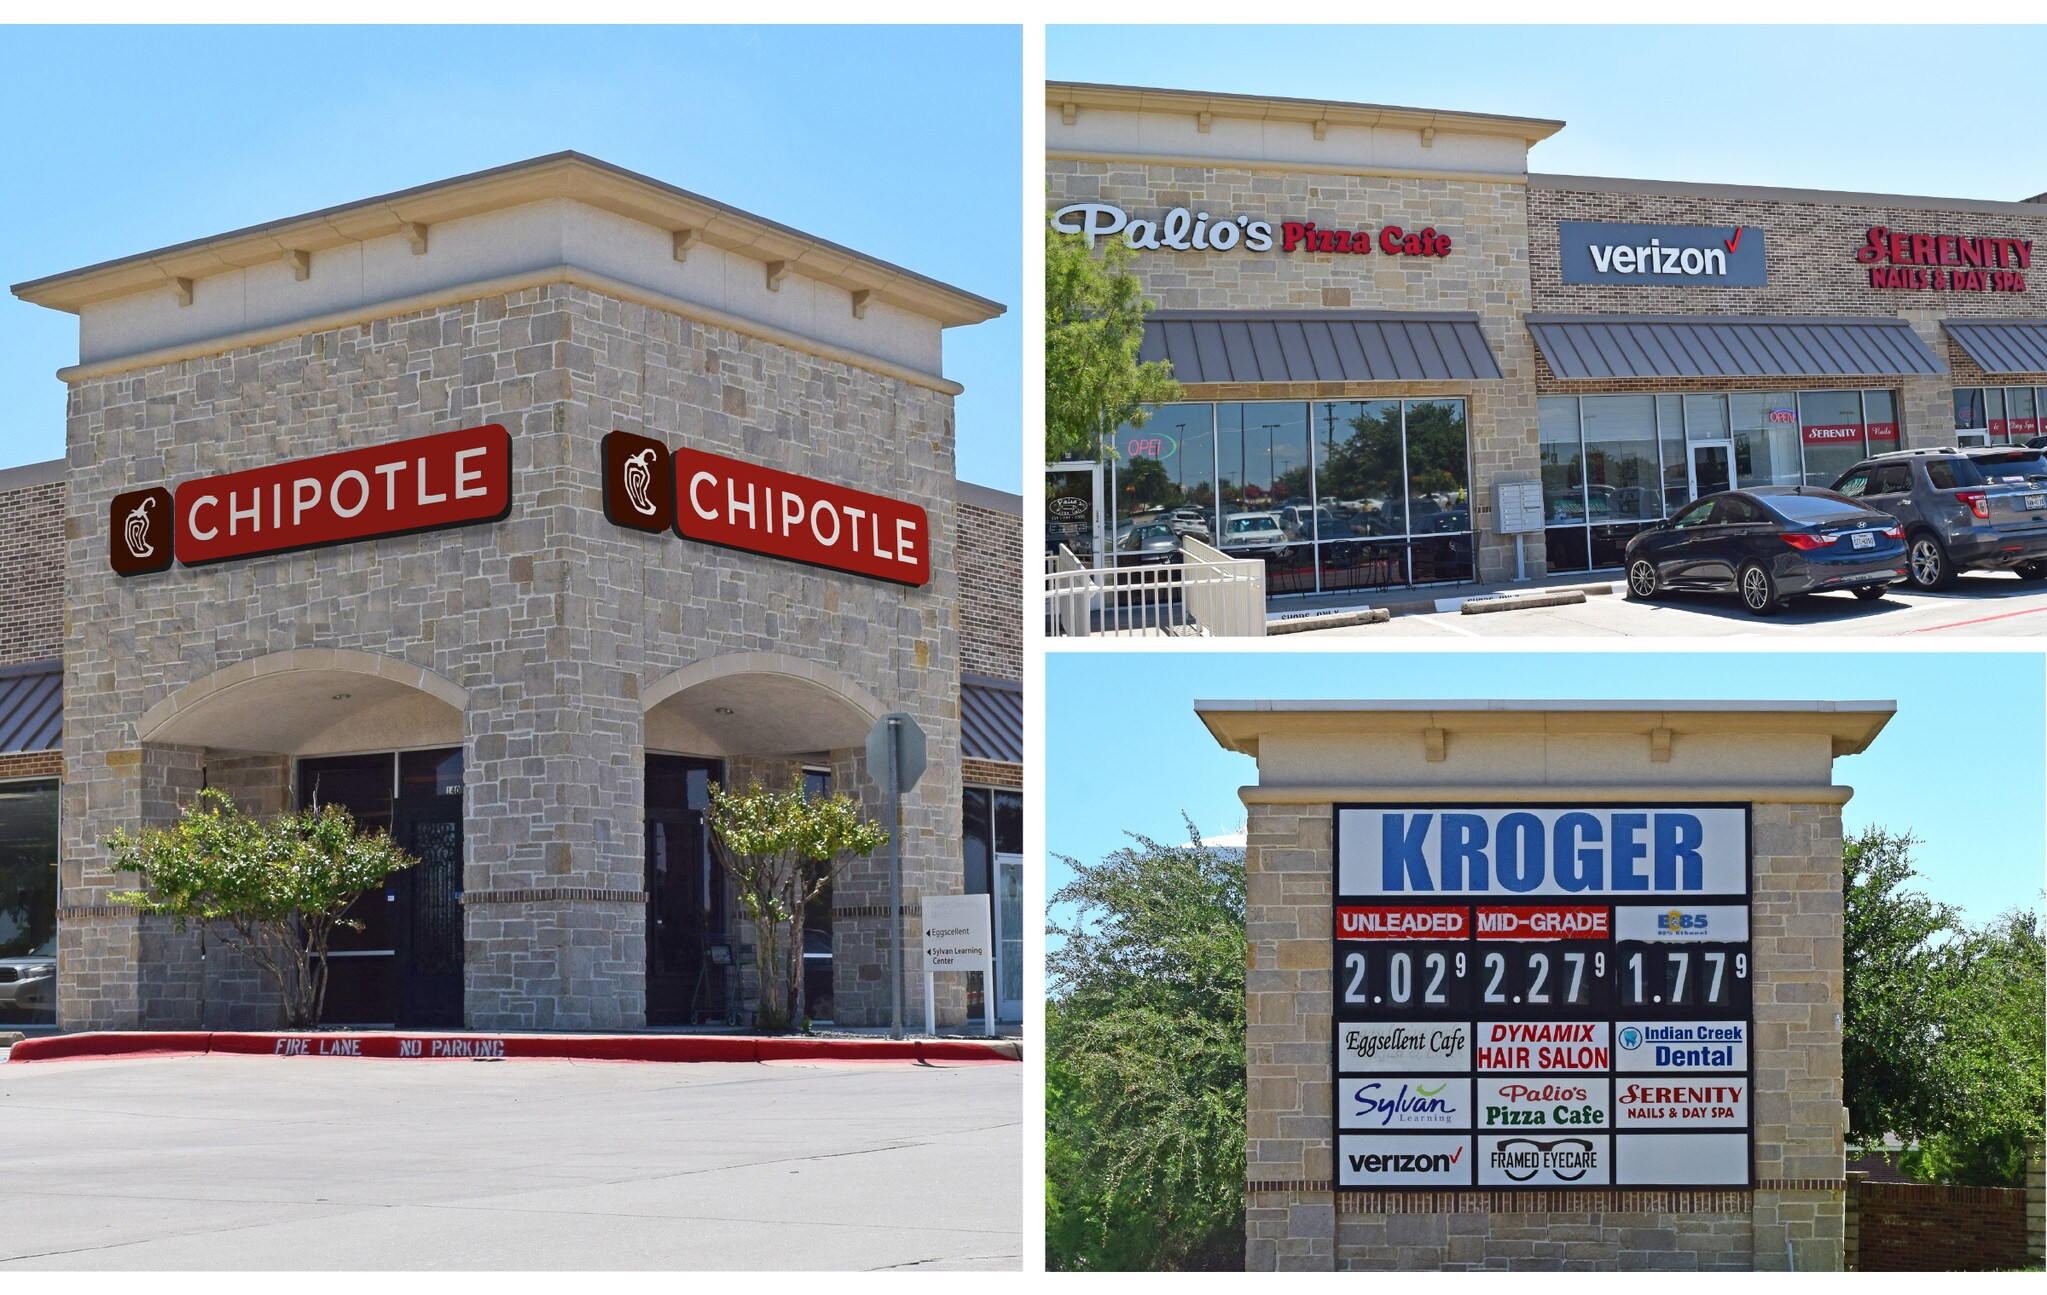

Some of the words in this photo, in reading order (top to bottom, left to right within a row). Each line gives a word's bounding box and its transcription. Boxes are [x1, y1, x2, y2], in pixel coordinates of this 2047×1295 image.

[1050, 203, 1273, 252] Palio's
[1282, 222, 1372, 254] Pizza
[1379, 226, 1452, 258] Cafe
[1857, 226, 2033, 268] SERENITY
[1589, 238, 1726, 275] verizon
[1870, 268, 1928, 289] NAILS
[1932, 270, 1947, 290] &
[1950, 269, 1989, 291] DAY
[1991, 271, 2027, 292] SPA
[1769, 411, 1795, 424] OPEN
[1809, 427, 1857, 439] SERENITY
[188, 446, 489, 541] CHIPOTLE
[689, 471, 918, 565] CHIPOTLE
[1382, 811, 1703, 892] KROGER
[1342, 913, 1463, 933] UNLEADED
[1478, 912, 1608, 932] MID-GRADE
[932, 928, 970, 938] Eggscellent
[932, 947, 953, 956] Sylvan
[954, 946, 983, 956] Learning
[932, 956, 954, 965] Center
[1345, 1028, 1426, 1058] Eggsellent
[1430, 1028, 1465, 1057] Cafe
[1490, 1024, 1596, 1043] DYNAMIX
[1645, 1026, 1694, 1041] Indian
[1697, 1026, 1742, 1041] Creek
[274, 1038, 311, 1055] FIRE
[319, 1039, 362, 1056] LANE
[400, 1039, 423, 1056] NO
[431, 1039, 505, 1057] PARKING
[1478, 1046, 1530, 1069] HAIR
[1538, 1047, 1609, 1069] SALON
[1655, 1046, 1733, 1066] Dental
[1498, 1084, 1588, 1102] Palio's
[1619, 1084, 1742, 1104] SERENITY
[1355, 1082, 1456, 1126] Sylvan
[1628, 1107, 1666, 1119] NAILS
[1668, 1107, 1679, 1119] &
[1682, 1107, 1708, 1119] DAY
[1711, 1107, 1735, 1119] SPA
[1399, 1113, 1454, 1125] Learning
[1486, 1106, 1547, 1126] Pizza
[1552, 1105, 1604, 1126] Cafe
[1348, 1153, 1450, 1173] verizon
[1491, 1151, 1540, 1169] FRAMED
[1544, 1151, 1598, 1169] EYECARE
